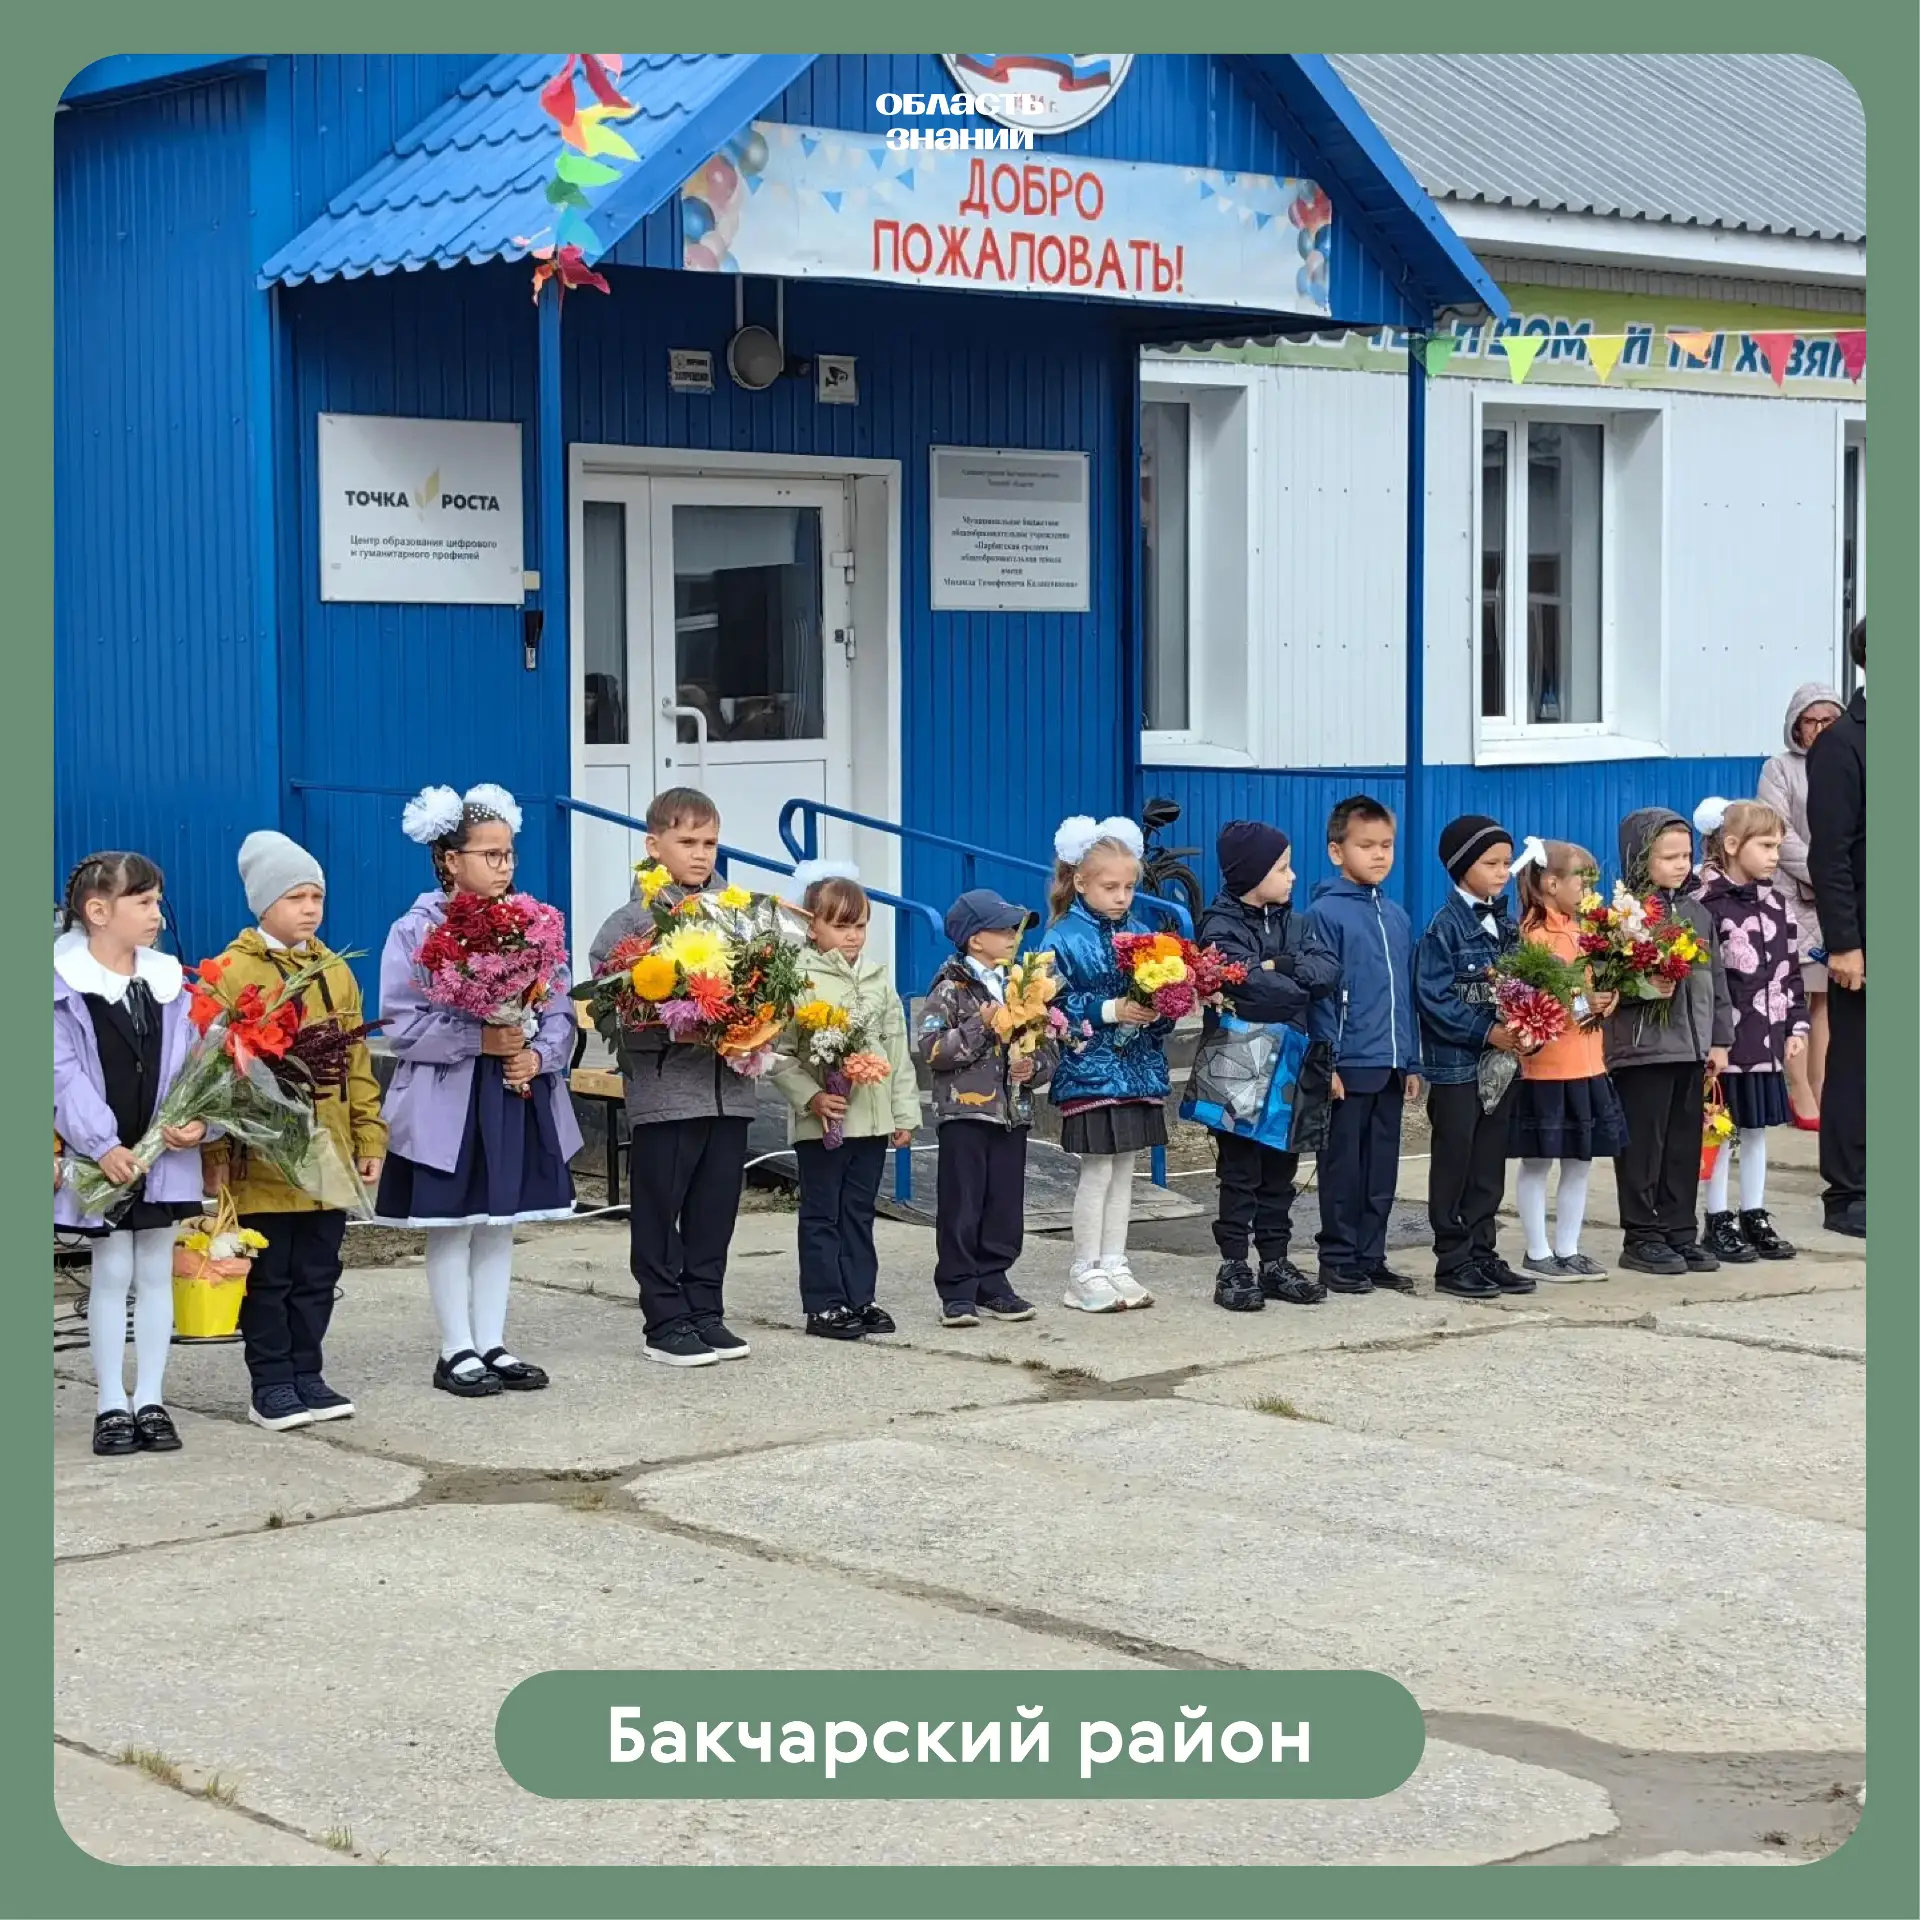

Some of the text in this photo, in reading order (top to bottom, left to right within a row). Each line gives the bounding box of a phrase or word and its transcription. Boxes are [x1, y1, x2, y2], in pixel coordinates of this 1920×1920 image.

[959, 158, 1103, 220] ДОБРО
[873, 219, 1185, 293] ПОЖАЛОВАТЬ!
[1622, 325, 1653, 366] И
[344, 490, 500, 511] ТОЧКА РОСТА
[350, 535, 498, 549] Центр образования цифрового
[359, 550, 431, 559] гуманитарного
[432, 551, 480, 561] профилей
